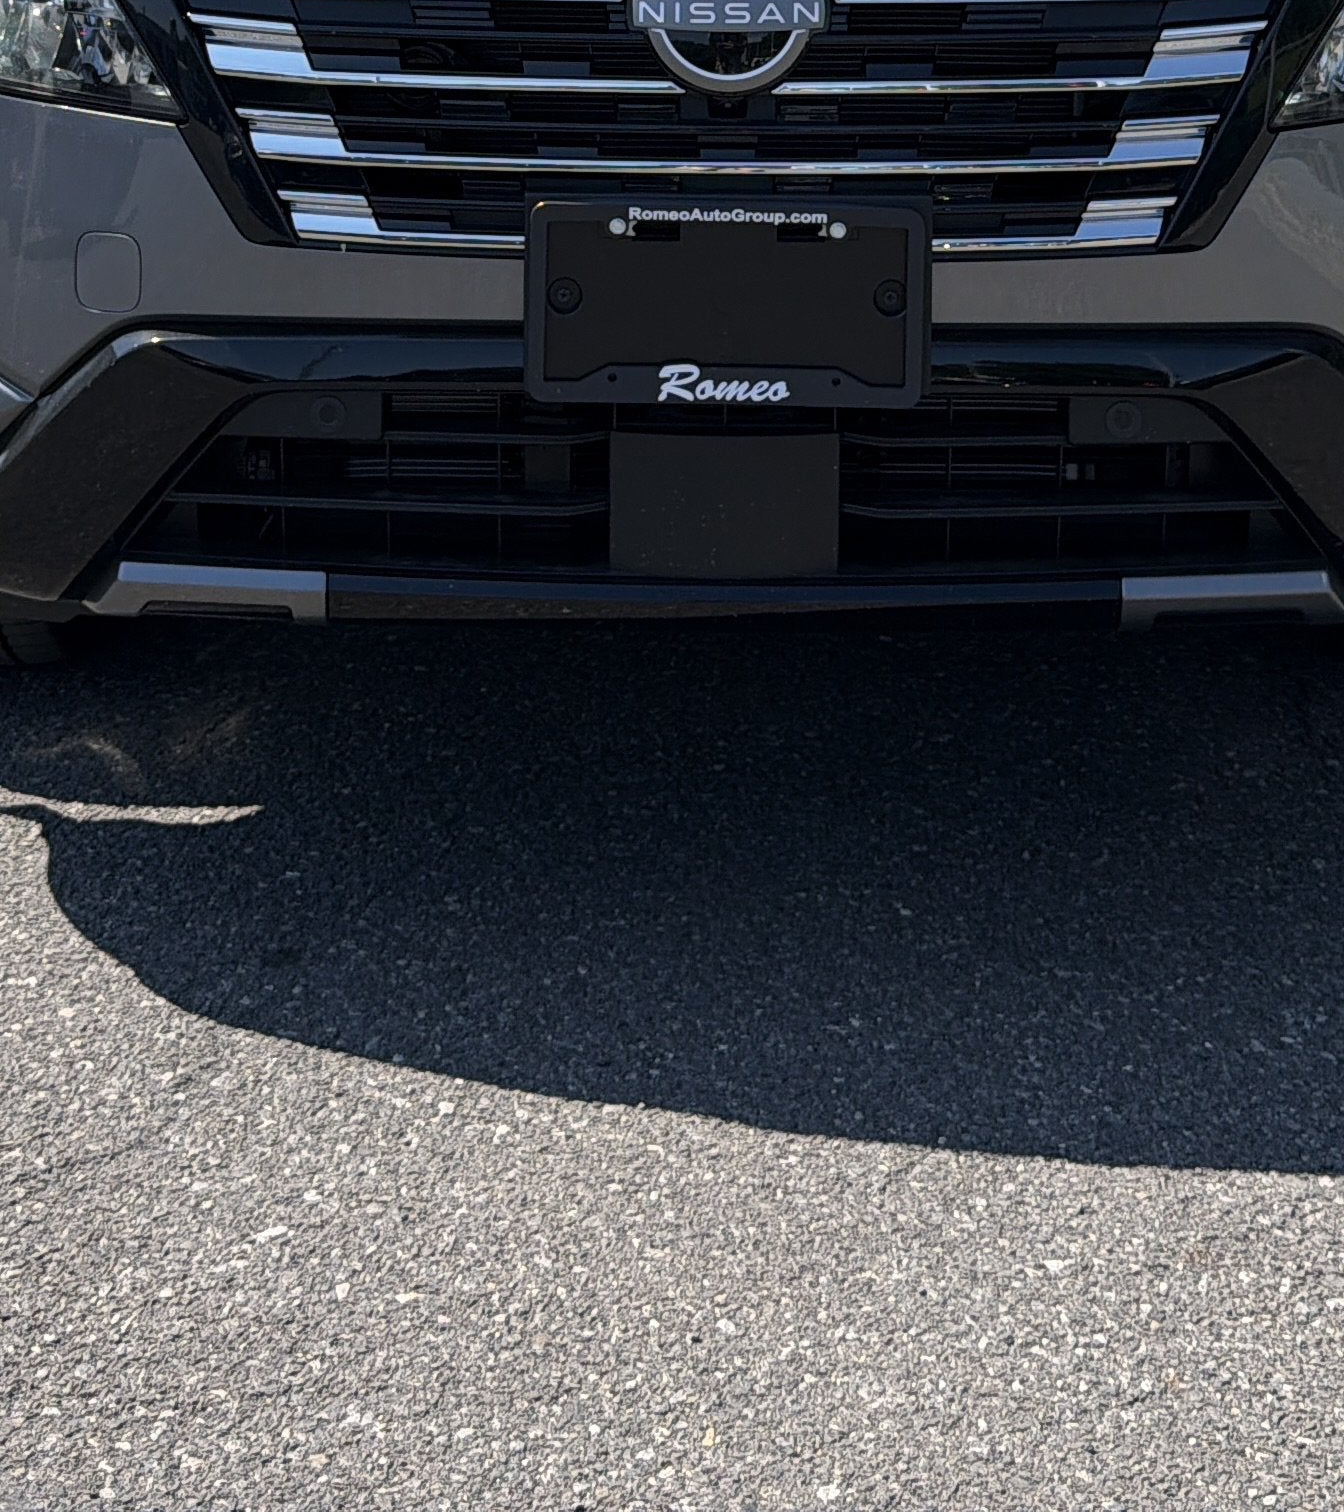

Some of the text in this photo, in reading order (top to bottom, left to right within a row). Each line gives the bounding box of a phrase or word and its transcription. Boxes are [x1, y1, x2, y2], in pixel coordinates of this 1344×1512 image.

[638, 1, 820, 24] NISSAN
[628, 206, 828, 226] RomeoAutoGroup.com
[657, 363, 791, 402] Romeo
